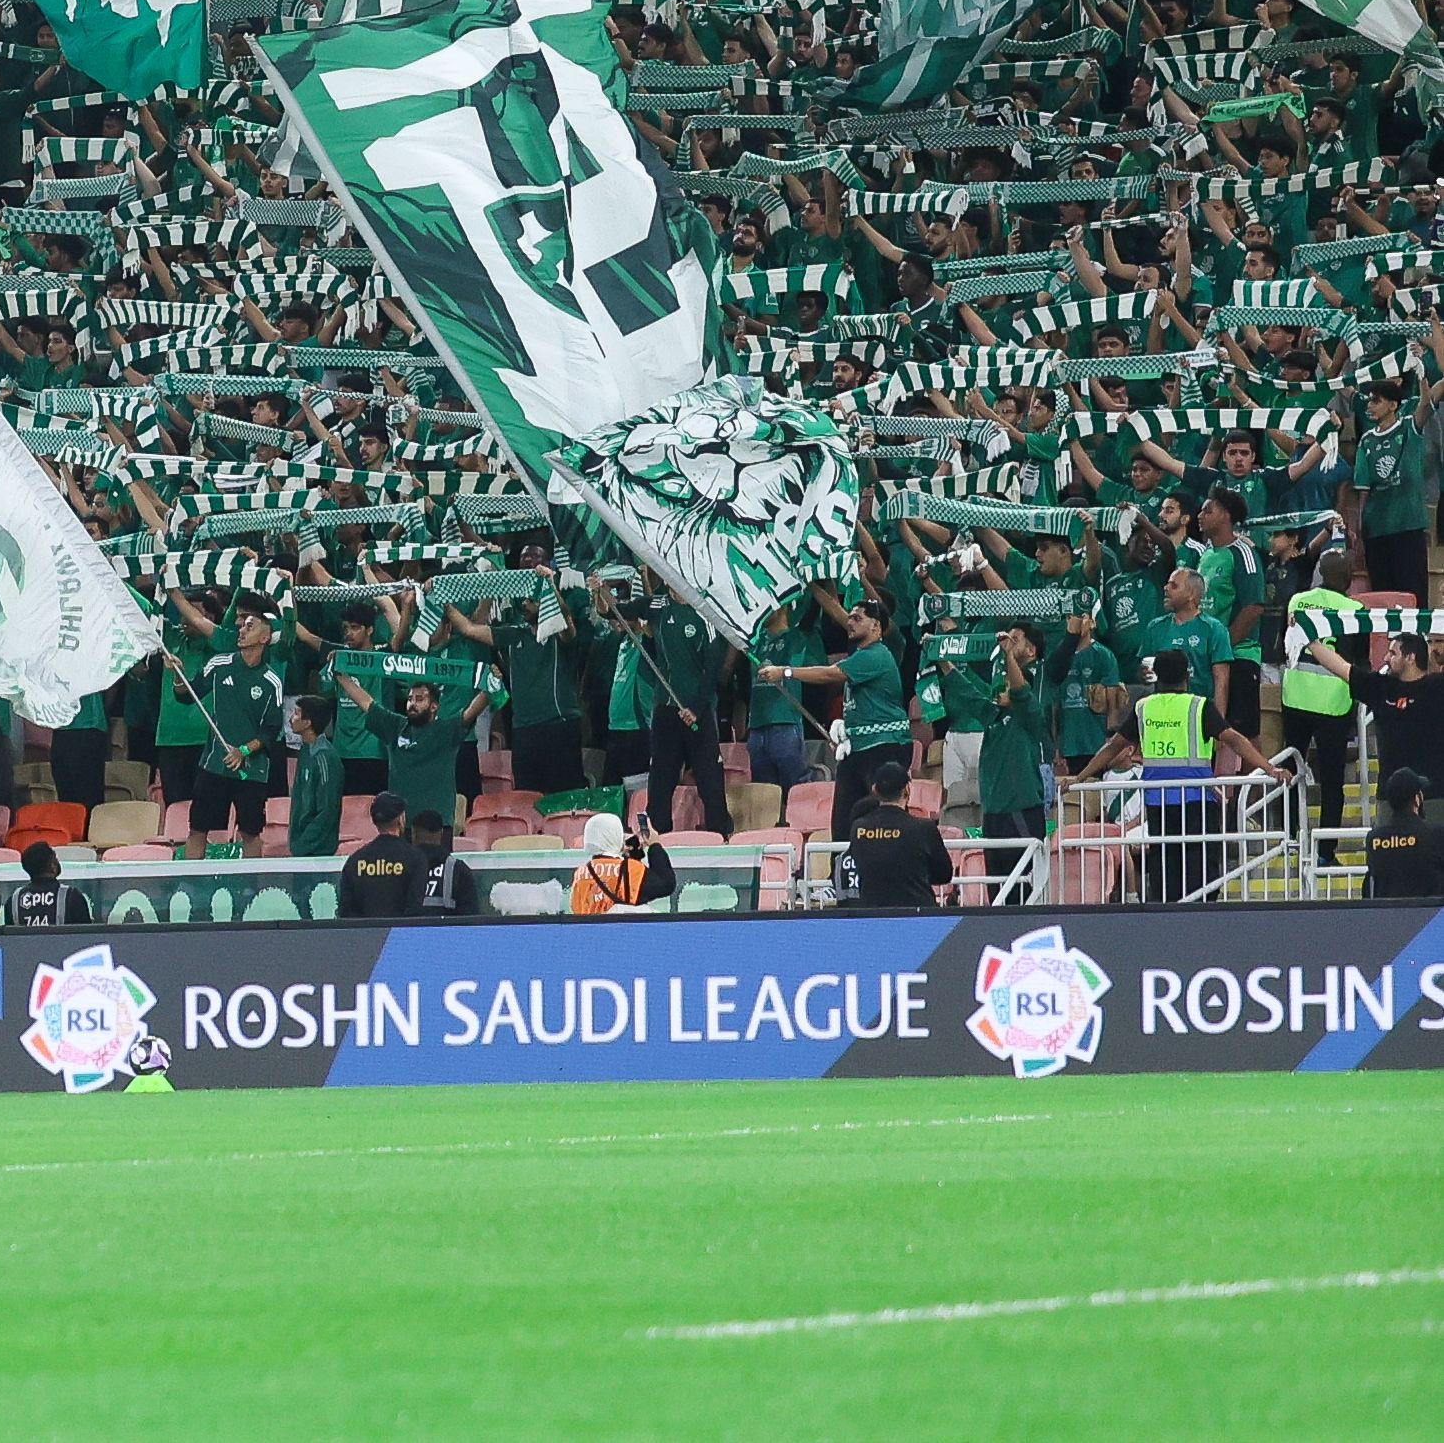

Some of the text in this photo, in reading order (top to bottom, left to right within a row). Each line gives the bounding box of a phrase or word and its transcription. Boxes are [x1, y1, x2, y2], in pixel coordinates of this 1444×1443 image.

[1145, 718, 1182, 730] Organizer
[1151, 739, 1177, 757] 136
[856, 826, 901, 840] Police
[1372, 834, 1416, 850] Police
[357, 859, 403, 876] Police
[22, 892, 54, 908] EPIC
[1018, 993, 1062, 1014] RSL
[1143, 965, 1393, 1034] ROSHN
[185, 973, 929, 1049] ROSHN SAUDI LEAGUE
[67, 1009, 110, 1031] RSL
